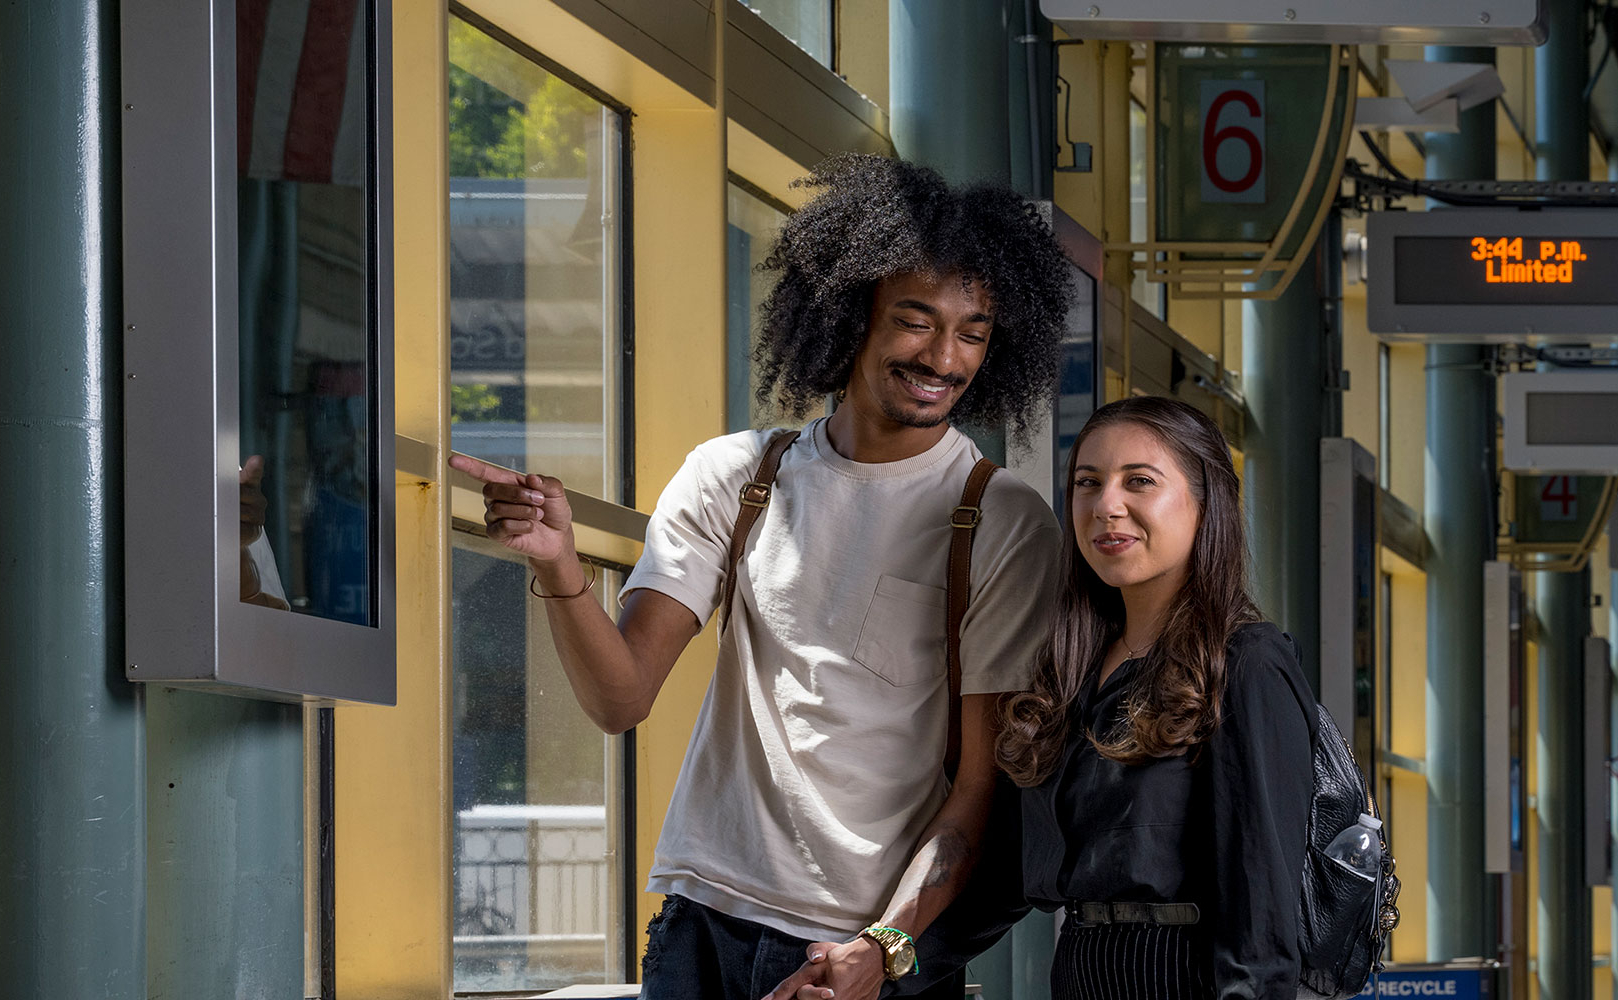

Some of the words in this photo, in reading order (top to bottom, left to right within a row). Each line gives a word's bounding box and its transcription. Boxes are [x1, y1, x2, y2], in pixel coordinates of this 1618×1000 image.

[1202, 89, 1263, 193] 6
[1471, 237, 1523, 261] 3:44
[1486, 259, 1573, 283] Limited
[1542, 475, 1576, 516] 4
[1378, 980, 1456, 996] RECYCLE
